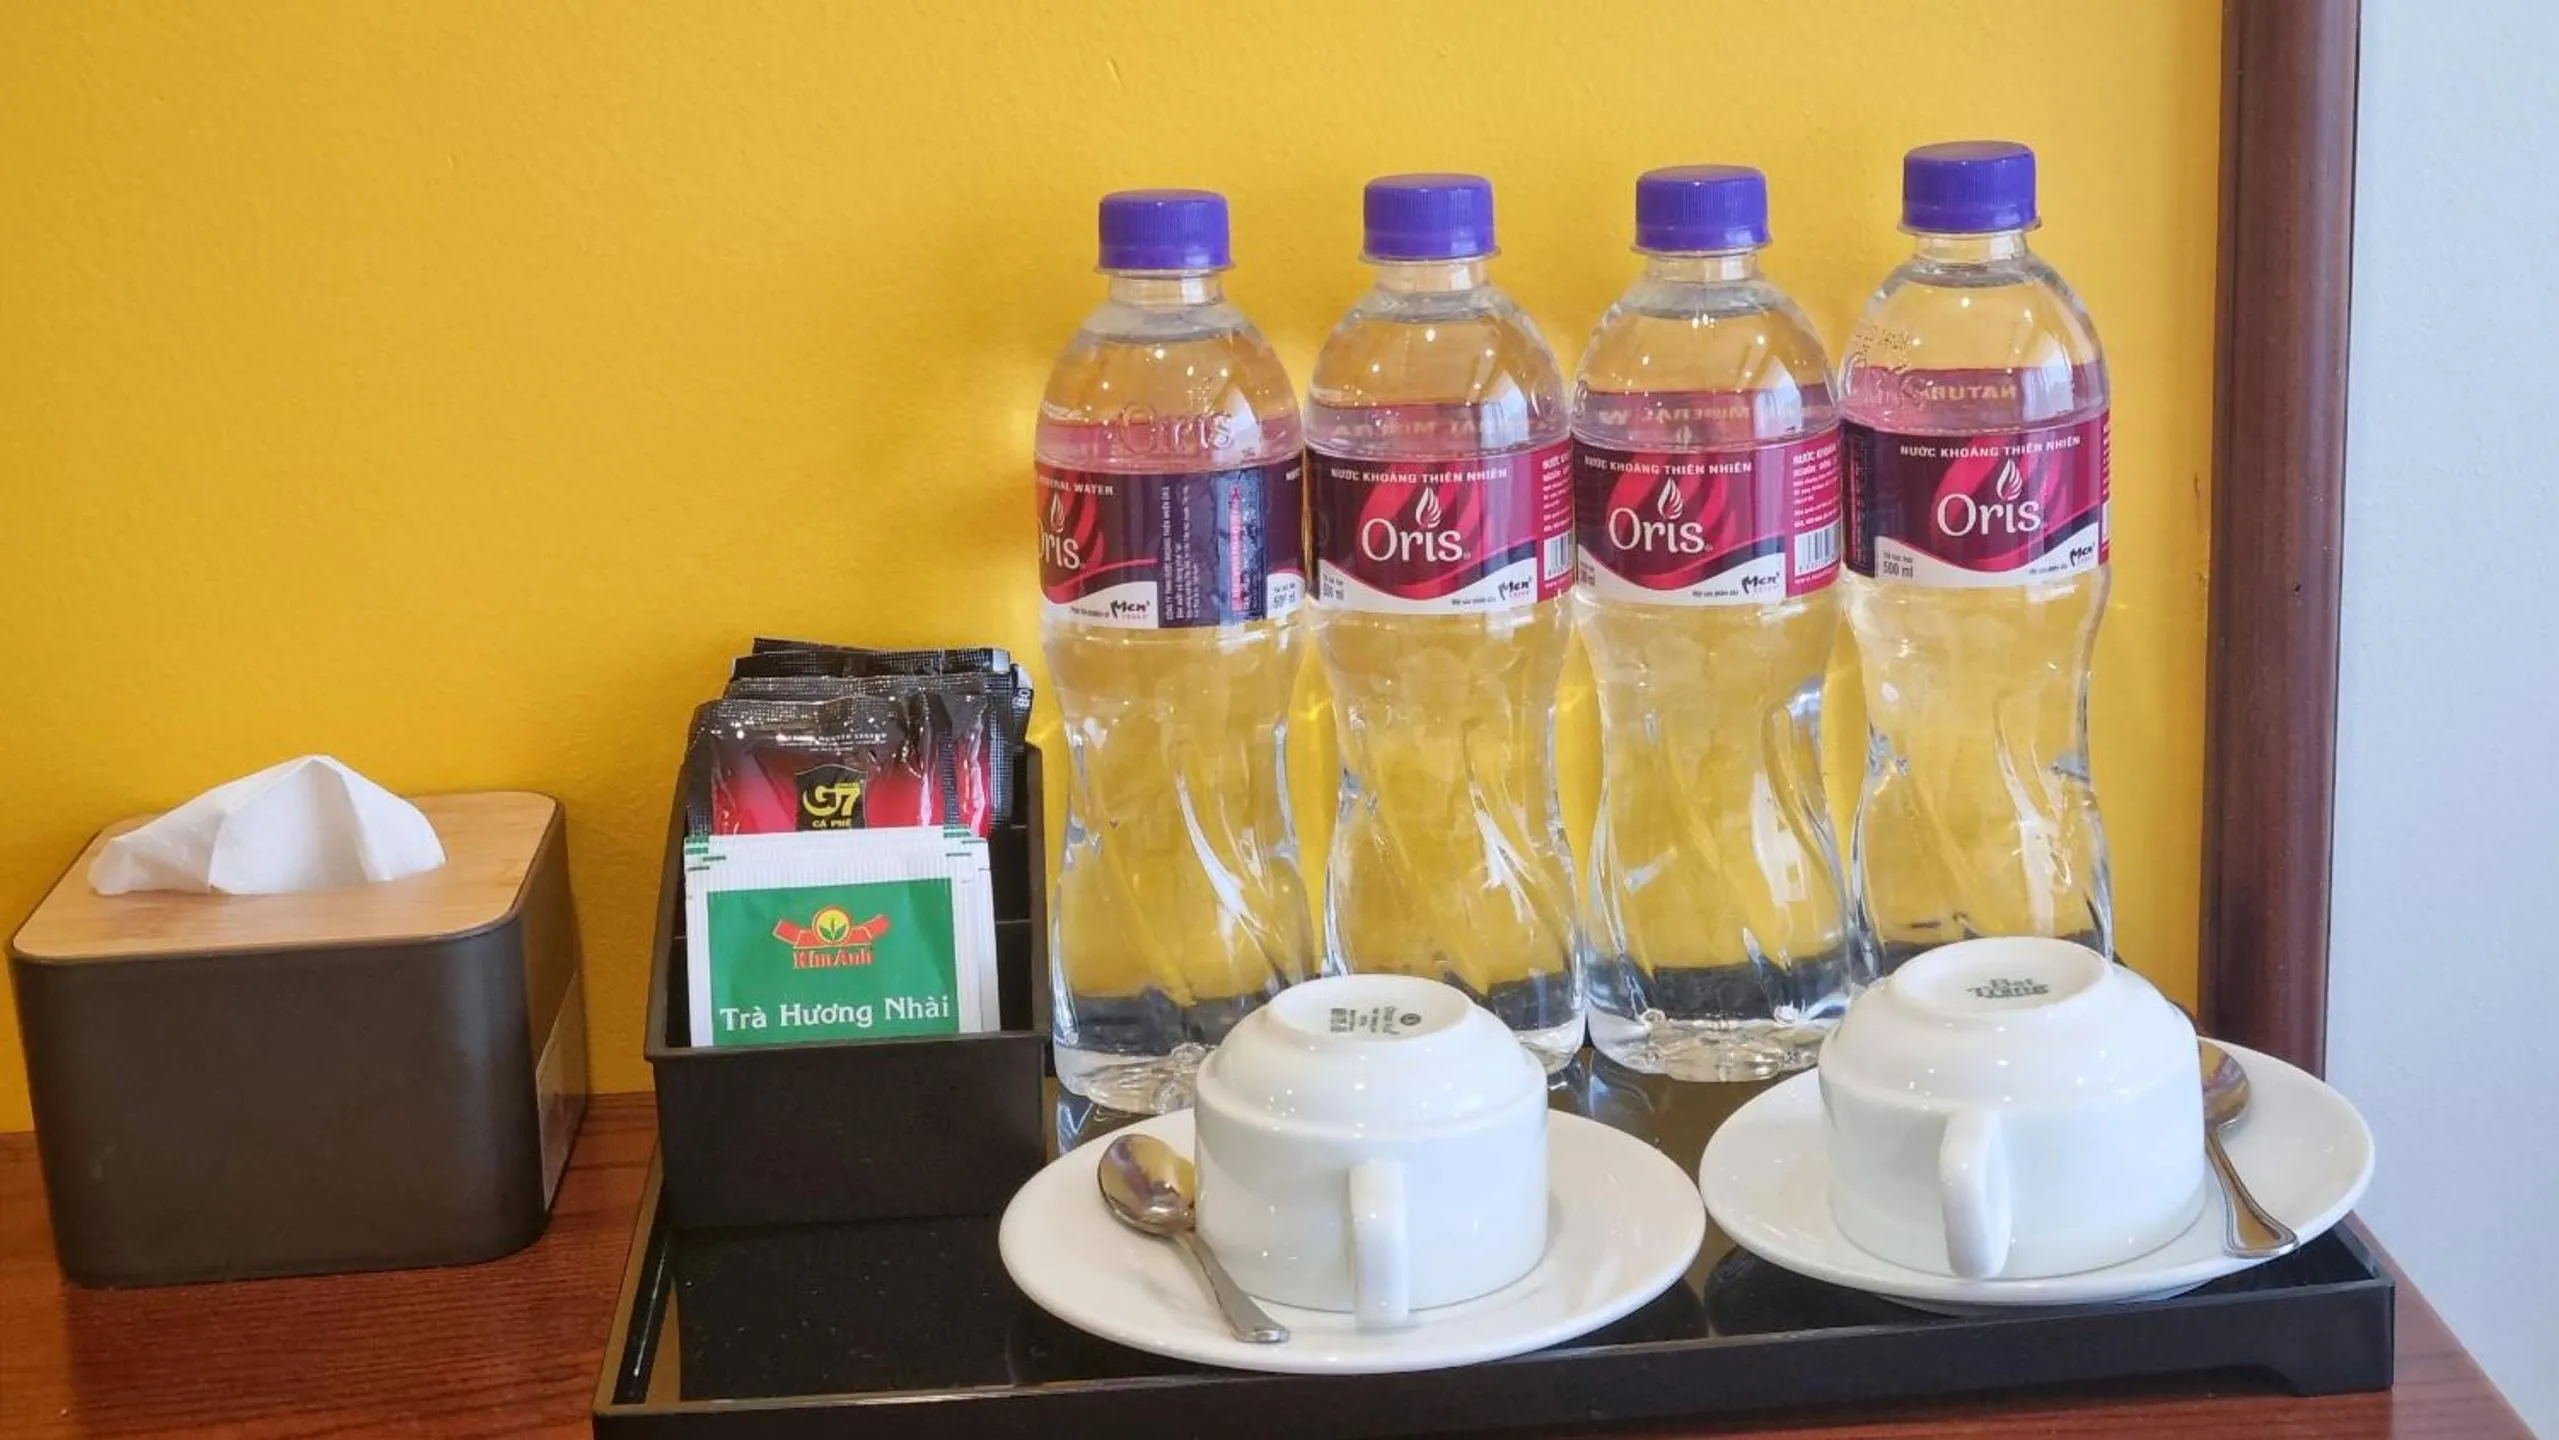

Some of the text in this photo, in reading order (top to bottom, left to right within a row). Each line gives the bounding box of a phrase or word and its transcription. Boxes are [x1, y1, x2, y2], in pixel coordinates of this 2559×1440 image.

[1074, 484, 1114, 496] WATER
[1609, 507, 1706, 553] Oris
[1937, 493, 2041, 536] Oris
[1362, 518, 1463, 562] Oris
[803, 783, 861, 816] G7
[720, 995, 950, 1031] Trà Hương Nhài
